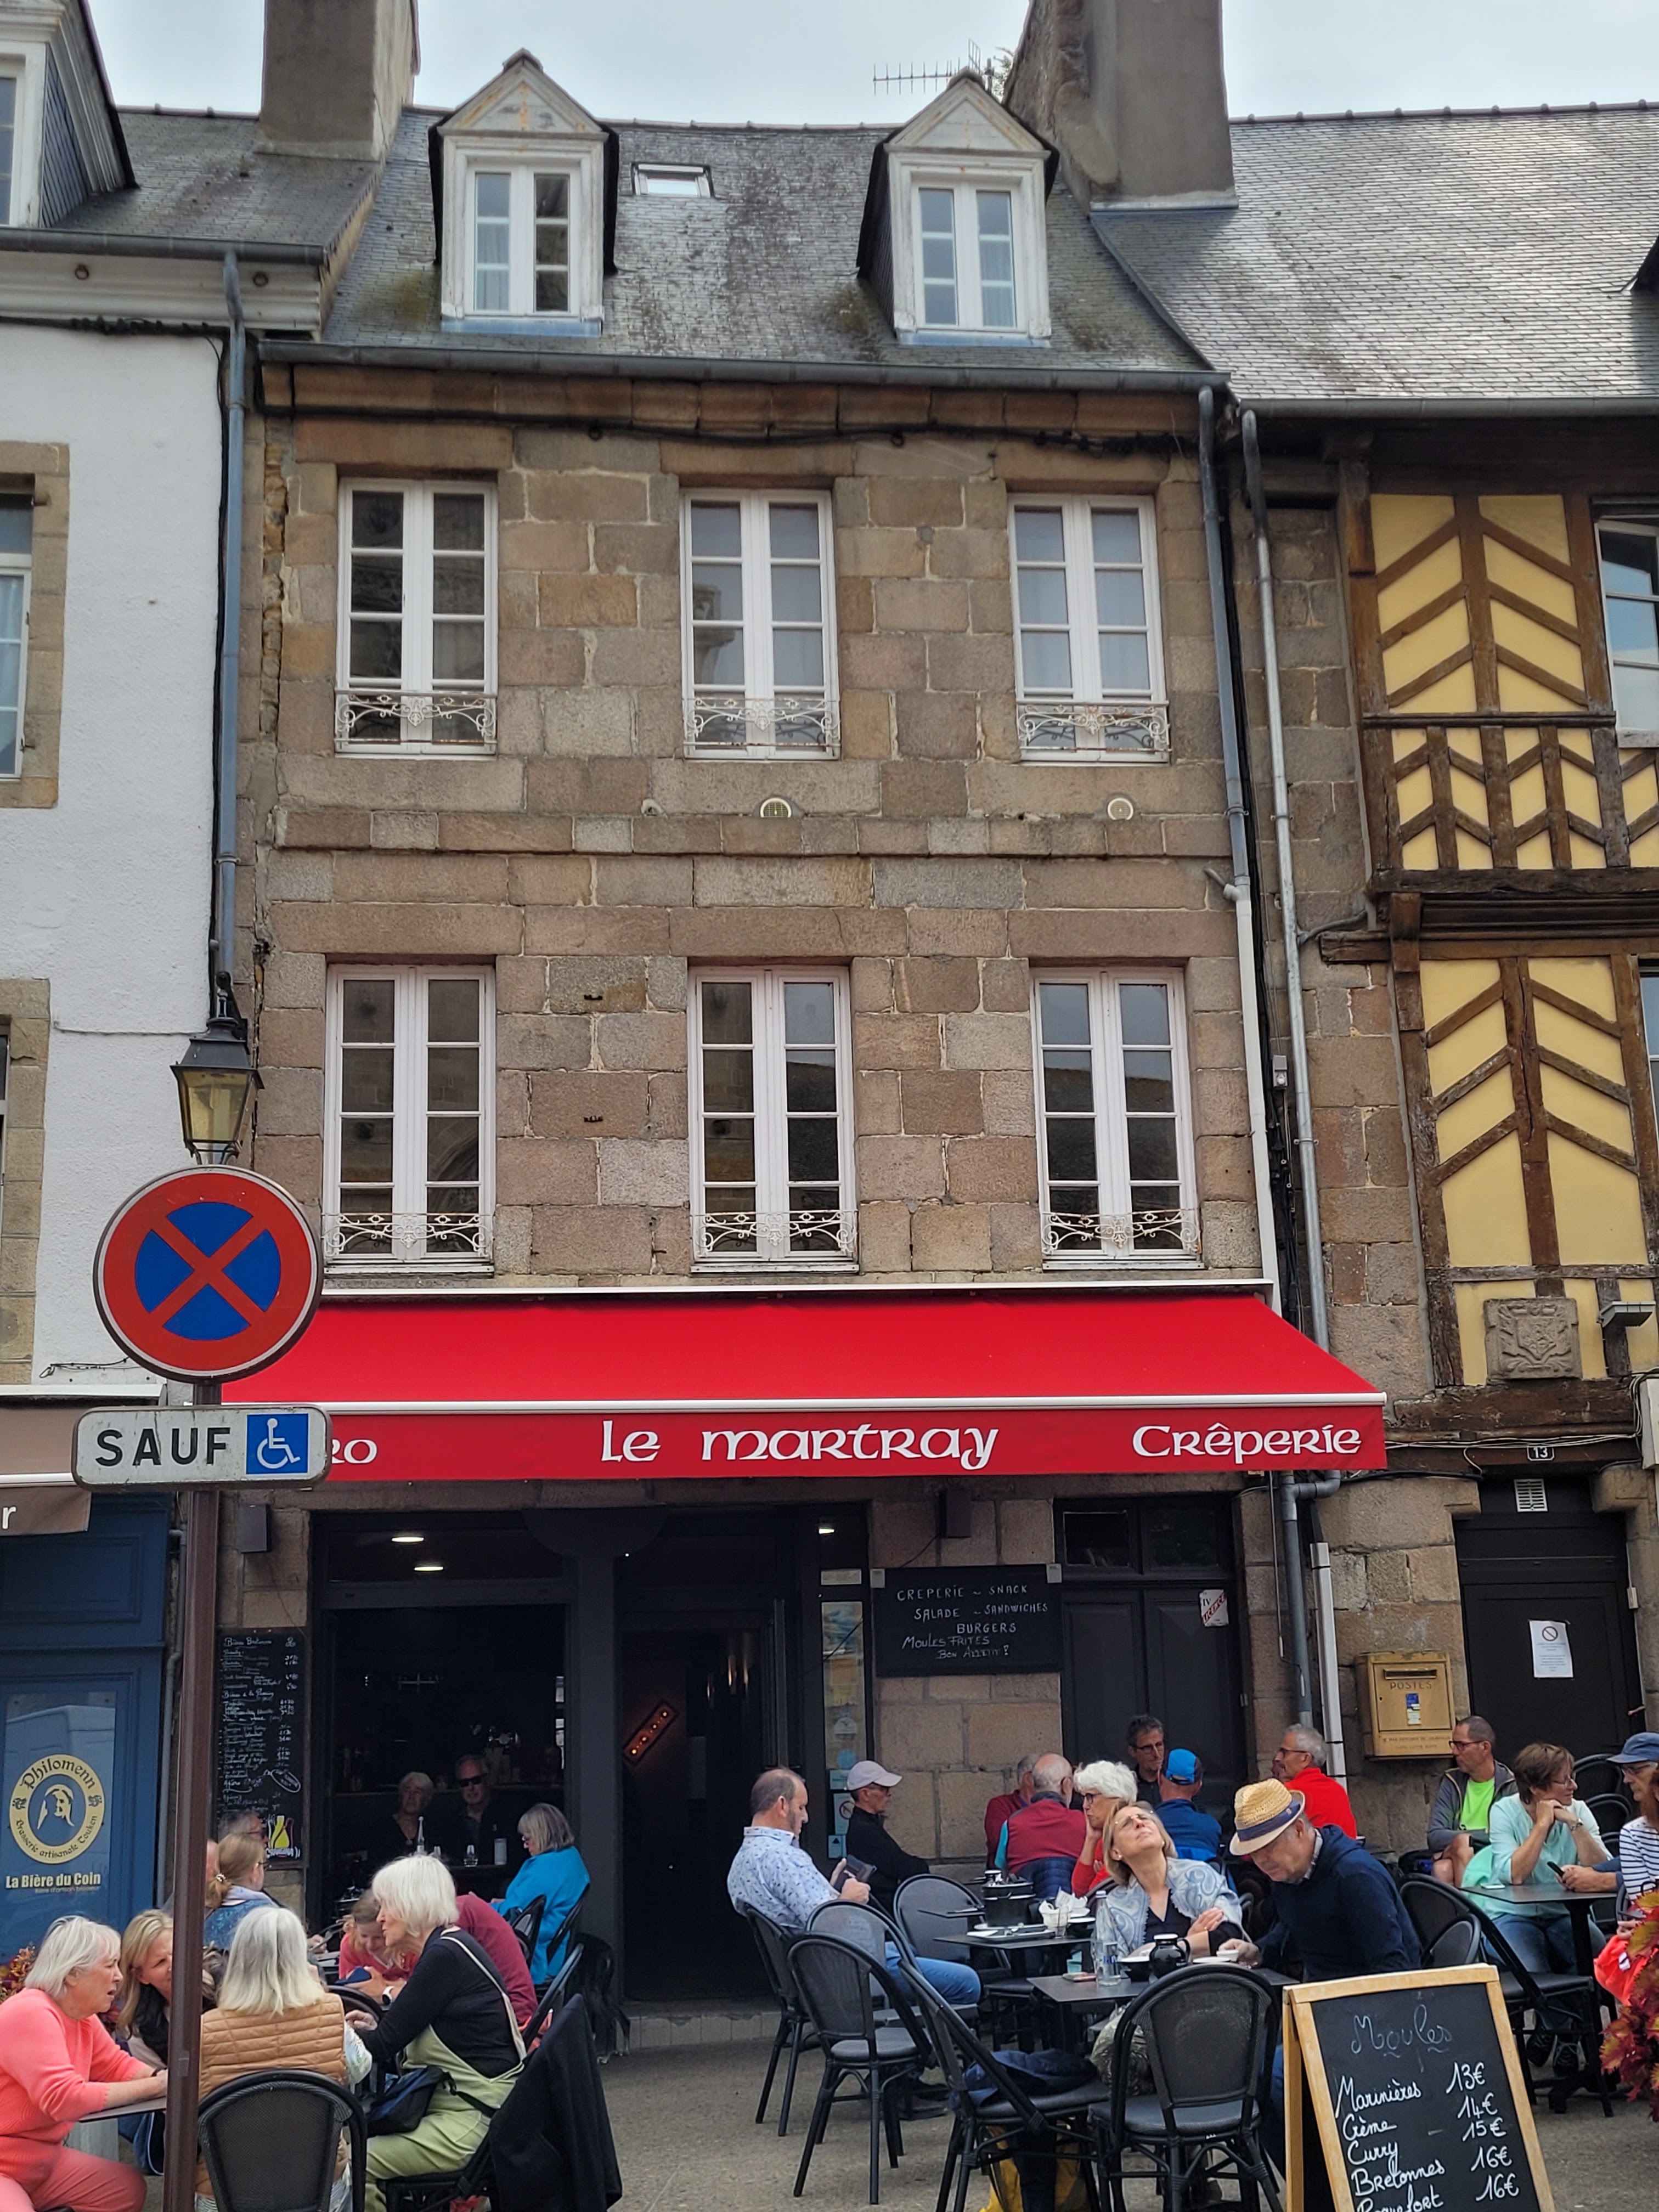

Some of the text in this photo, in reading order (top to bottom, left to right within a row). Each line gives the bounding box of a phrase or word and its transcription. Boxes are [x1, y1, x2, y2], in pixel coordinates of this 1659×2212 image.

[95, 1427, 230, 1467] SAUF
[601, 1420, 661, 1462] Le
[702, 1424, 998, 1470] martray
[1132, 1423, 1362, 1464] Crêperie
[1533, 1446, 1548, 1458] 13
[2, 1506, 16, 1529] r
[989, 1584, 1028, 1595] SNACK
[914, 1607, 960, 1623] SALADE
[957, 1622, 1016, 1634] BURGERS
[1390, 1681, 1432, 1690] POSTES
[20, 1758, 96, 1790] Philomenn
[5, 1871, 101, 1888] La Bière du Coin
[1351, 2004, 1452, 2054] Moules
[1335, 2062, 1486, 2118] Marinières 13€
[1342, 2092, 1498, 2141] Crème 14€
[1347, 2117, 1507, 2174] Curry 15€
[1470, 2146, 1513, 2171] 16€
[1476, 2173, 1519, 2202] 16€
